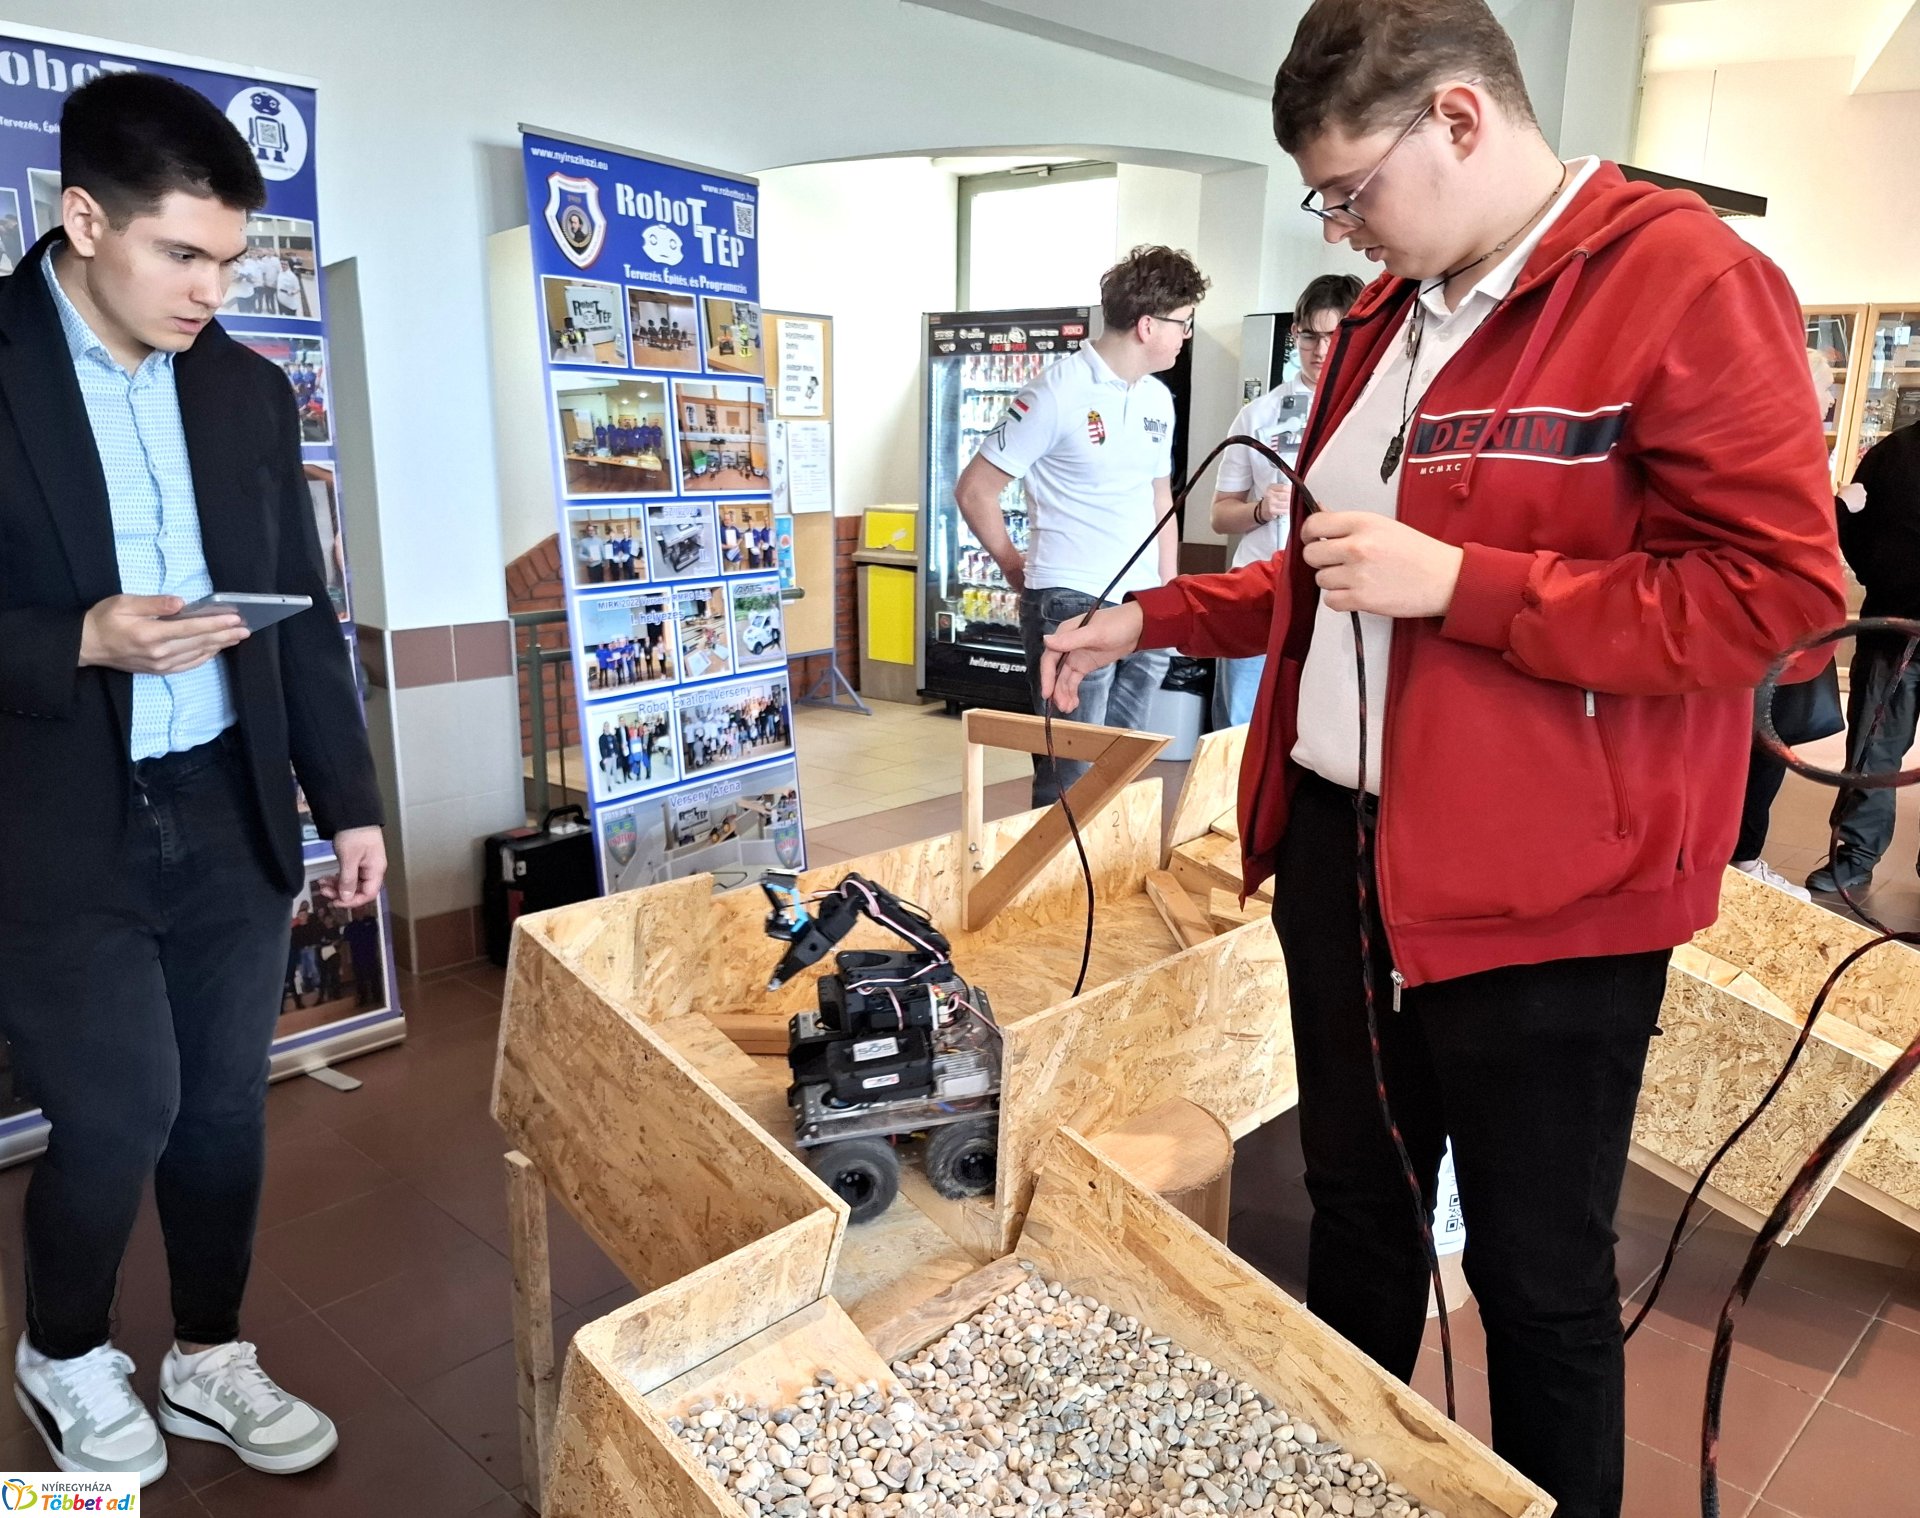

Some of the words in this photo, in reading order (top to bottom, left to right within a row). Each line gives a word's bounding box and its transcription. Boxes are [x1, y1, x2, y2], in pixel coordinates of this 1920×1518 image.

[615, 182, 707, 238] RoboT
[696, 223, 745, 268] TÉP
[1430, 416, 1568, 452] DENIM
[1420, 463, 1462, 475] MCMXC
[622, 598, 639, 608] 2022
[969, 656, 1027, 673] hellenergy.com
[638, 699, 669, 715] Robot
[712, 686, 752, 701] Verseny
[671, 790, 710, 808] Verseny
